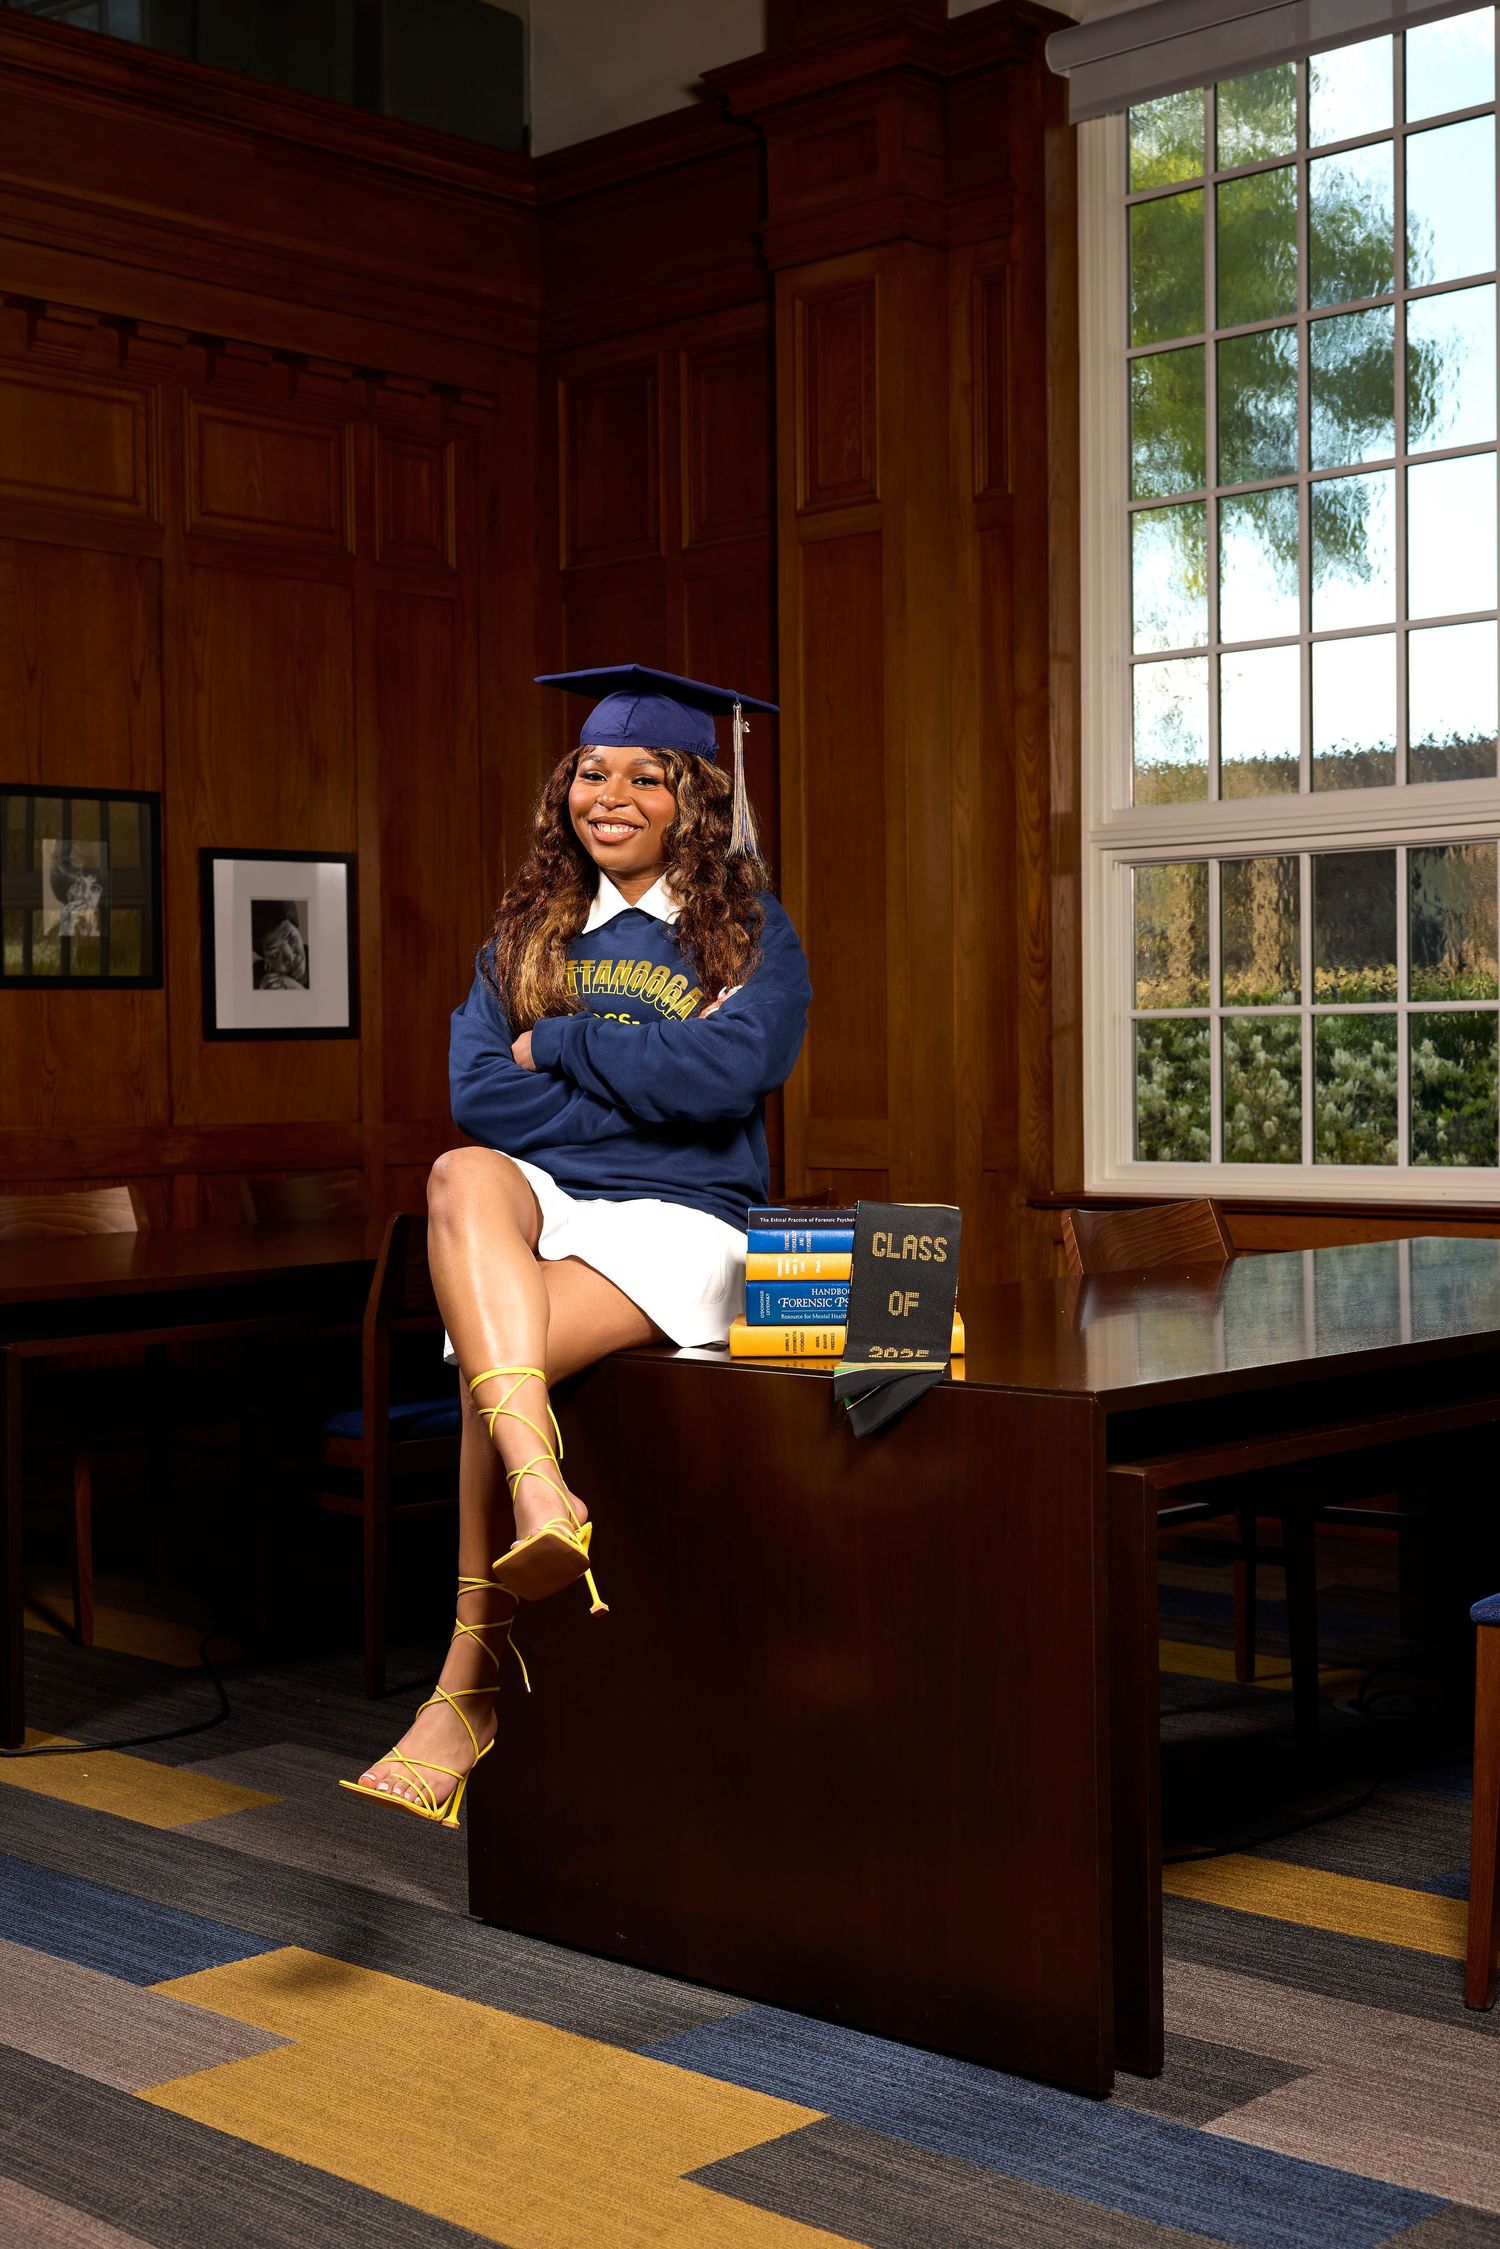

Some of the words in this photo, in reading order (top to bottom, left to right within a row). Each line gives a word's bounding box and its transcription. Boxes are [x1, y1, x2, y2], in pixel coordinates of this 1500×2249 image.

[562, 959, 704, 1023] TTANOOGA
[872, 1232, 948, 1263] CLASS
[778, 1297, 833, 1308] FORENSIC
[888, 1290, 920, 1317] OF
[869, 1345, 930, 1359] 2025
